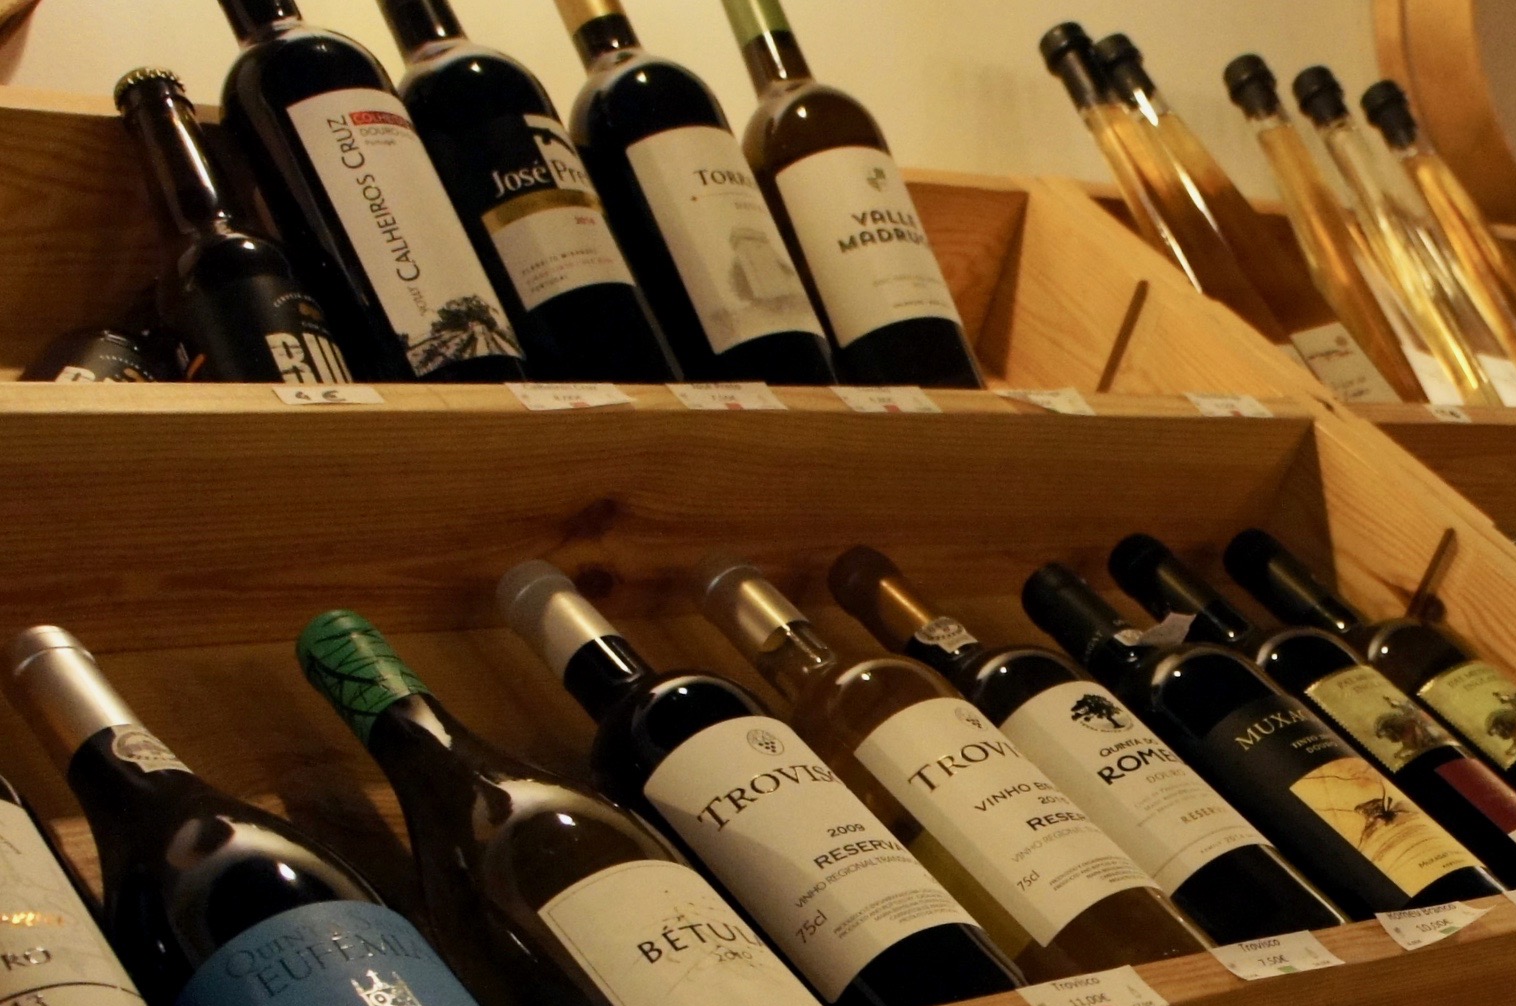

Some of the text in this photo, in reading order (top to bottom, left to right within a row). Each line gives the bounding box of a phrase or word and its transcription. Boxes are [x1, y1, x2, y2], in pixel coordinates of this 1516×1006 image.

[326, 114, 365, 170] CRUZ
[491, 159, 550, 198] José
[356, 173, 420, 282] CALHEIROS
[974, 783, 1032, 812] VINHO
[826, 823, 866, 838] 2009
[794, 880, 828, 909] VINHO
[1016, 871, 1041, 892] 75cl
[794, 909, 829, 944] 75cl
[1238, 939, 1281, 953] Trovisco
[1051, 976, 1100, 992] Trovisco
